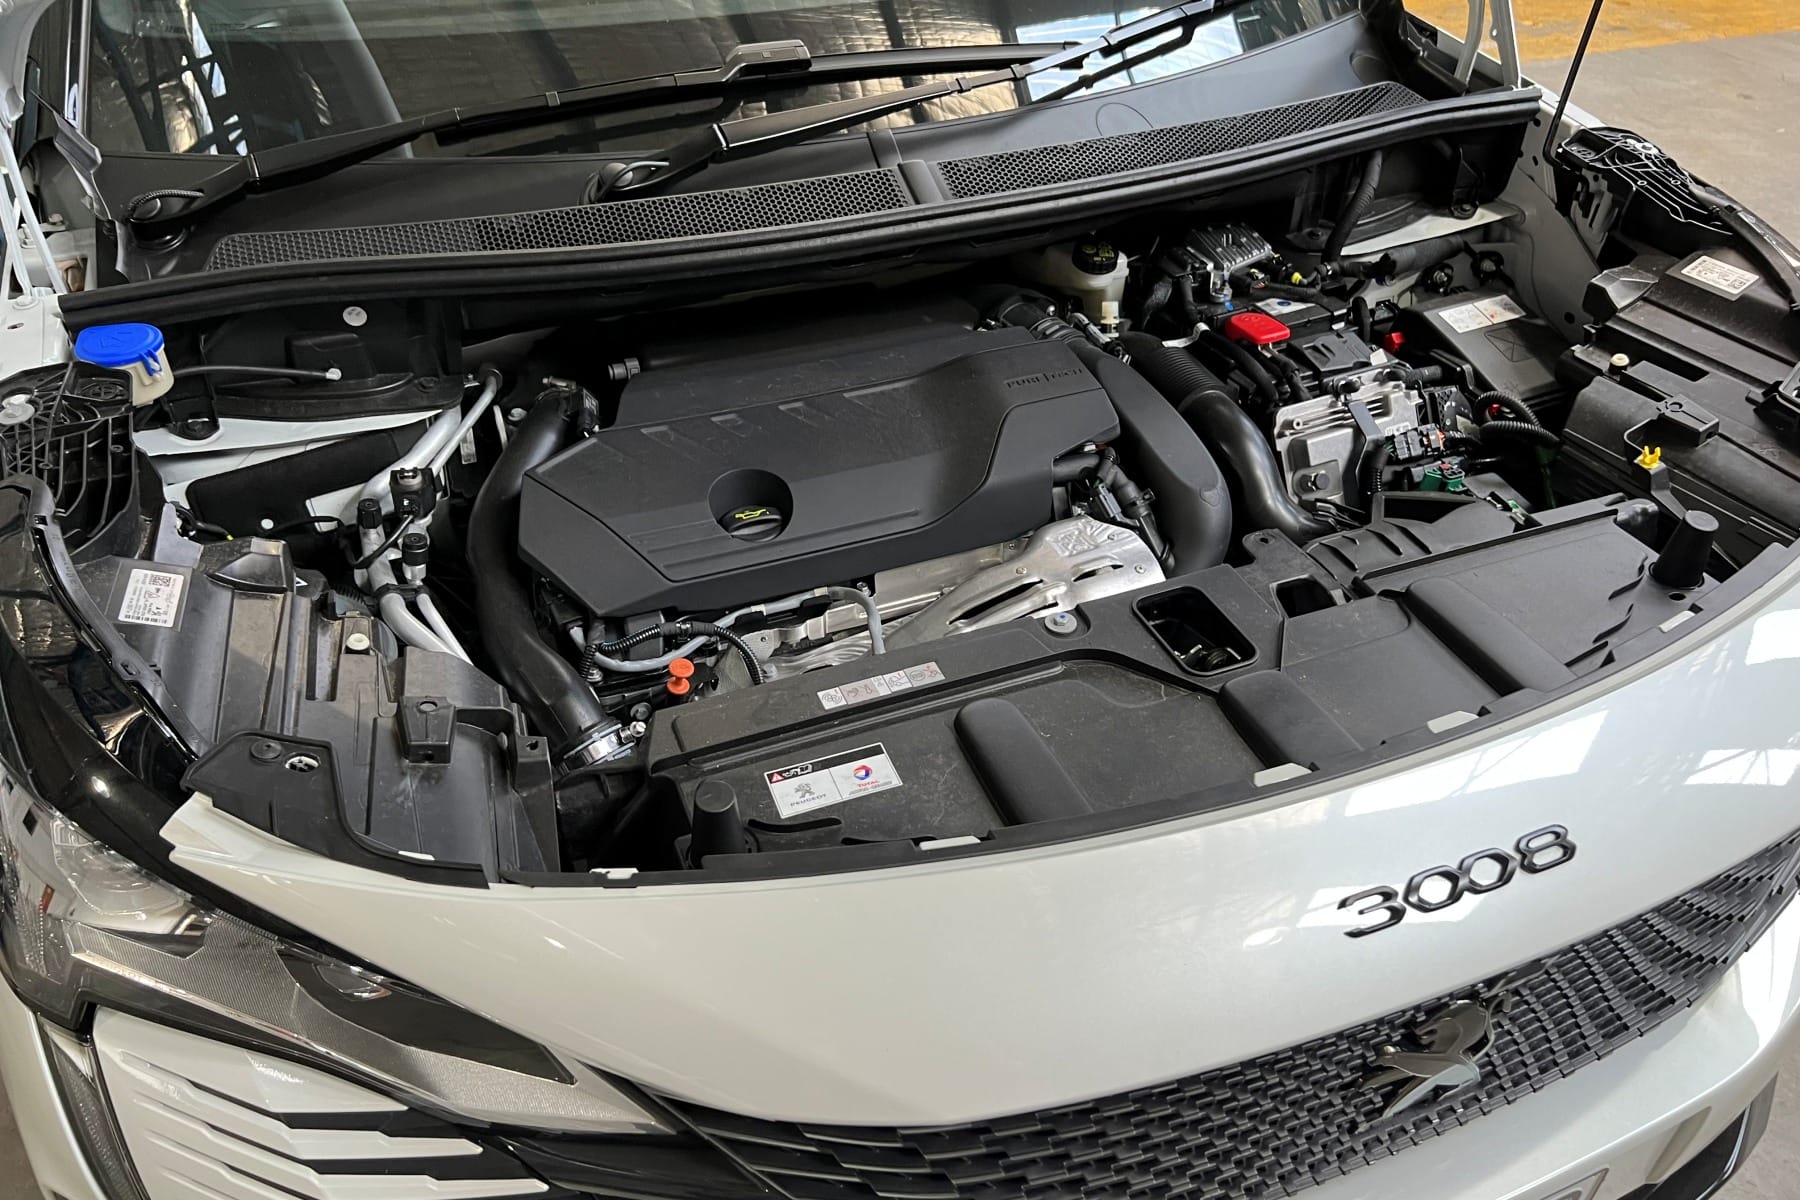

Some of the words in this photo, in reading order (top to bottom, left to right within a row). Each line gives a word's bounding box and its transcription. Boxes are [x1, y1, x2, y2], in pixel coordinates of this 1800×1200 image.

[857, 780, 880, 788] TOTAL
[790, 793, 827, 807] PEUGEOT
[1336, 824, 1577, 939] 3008
